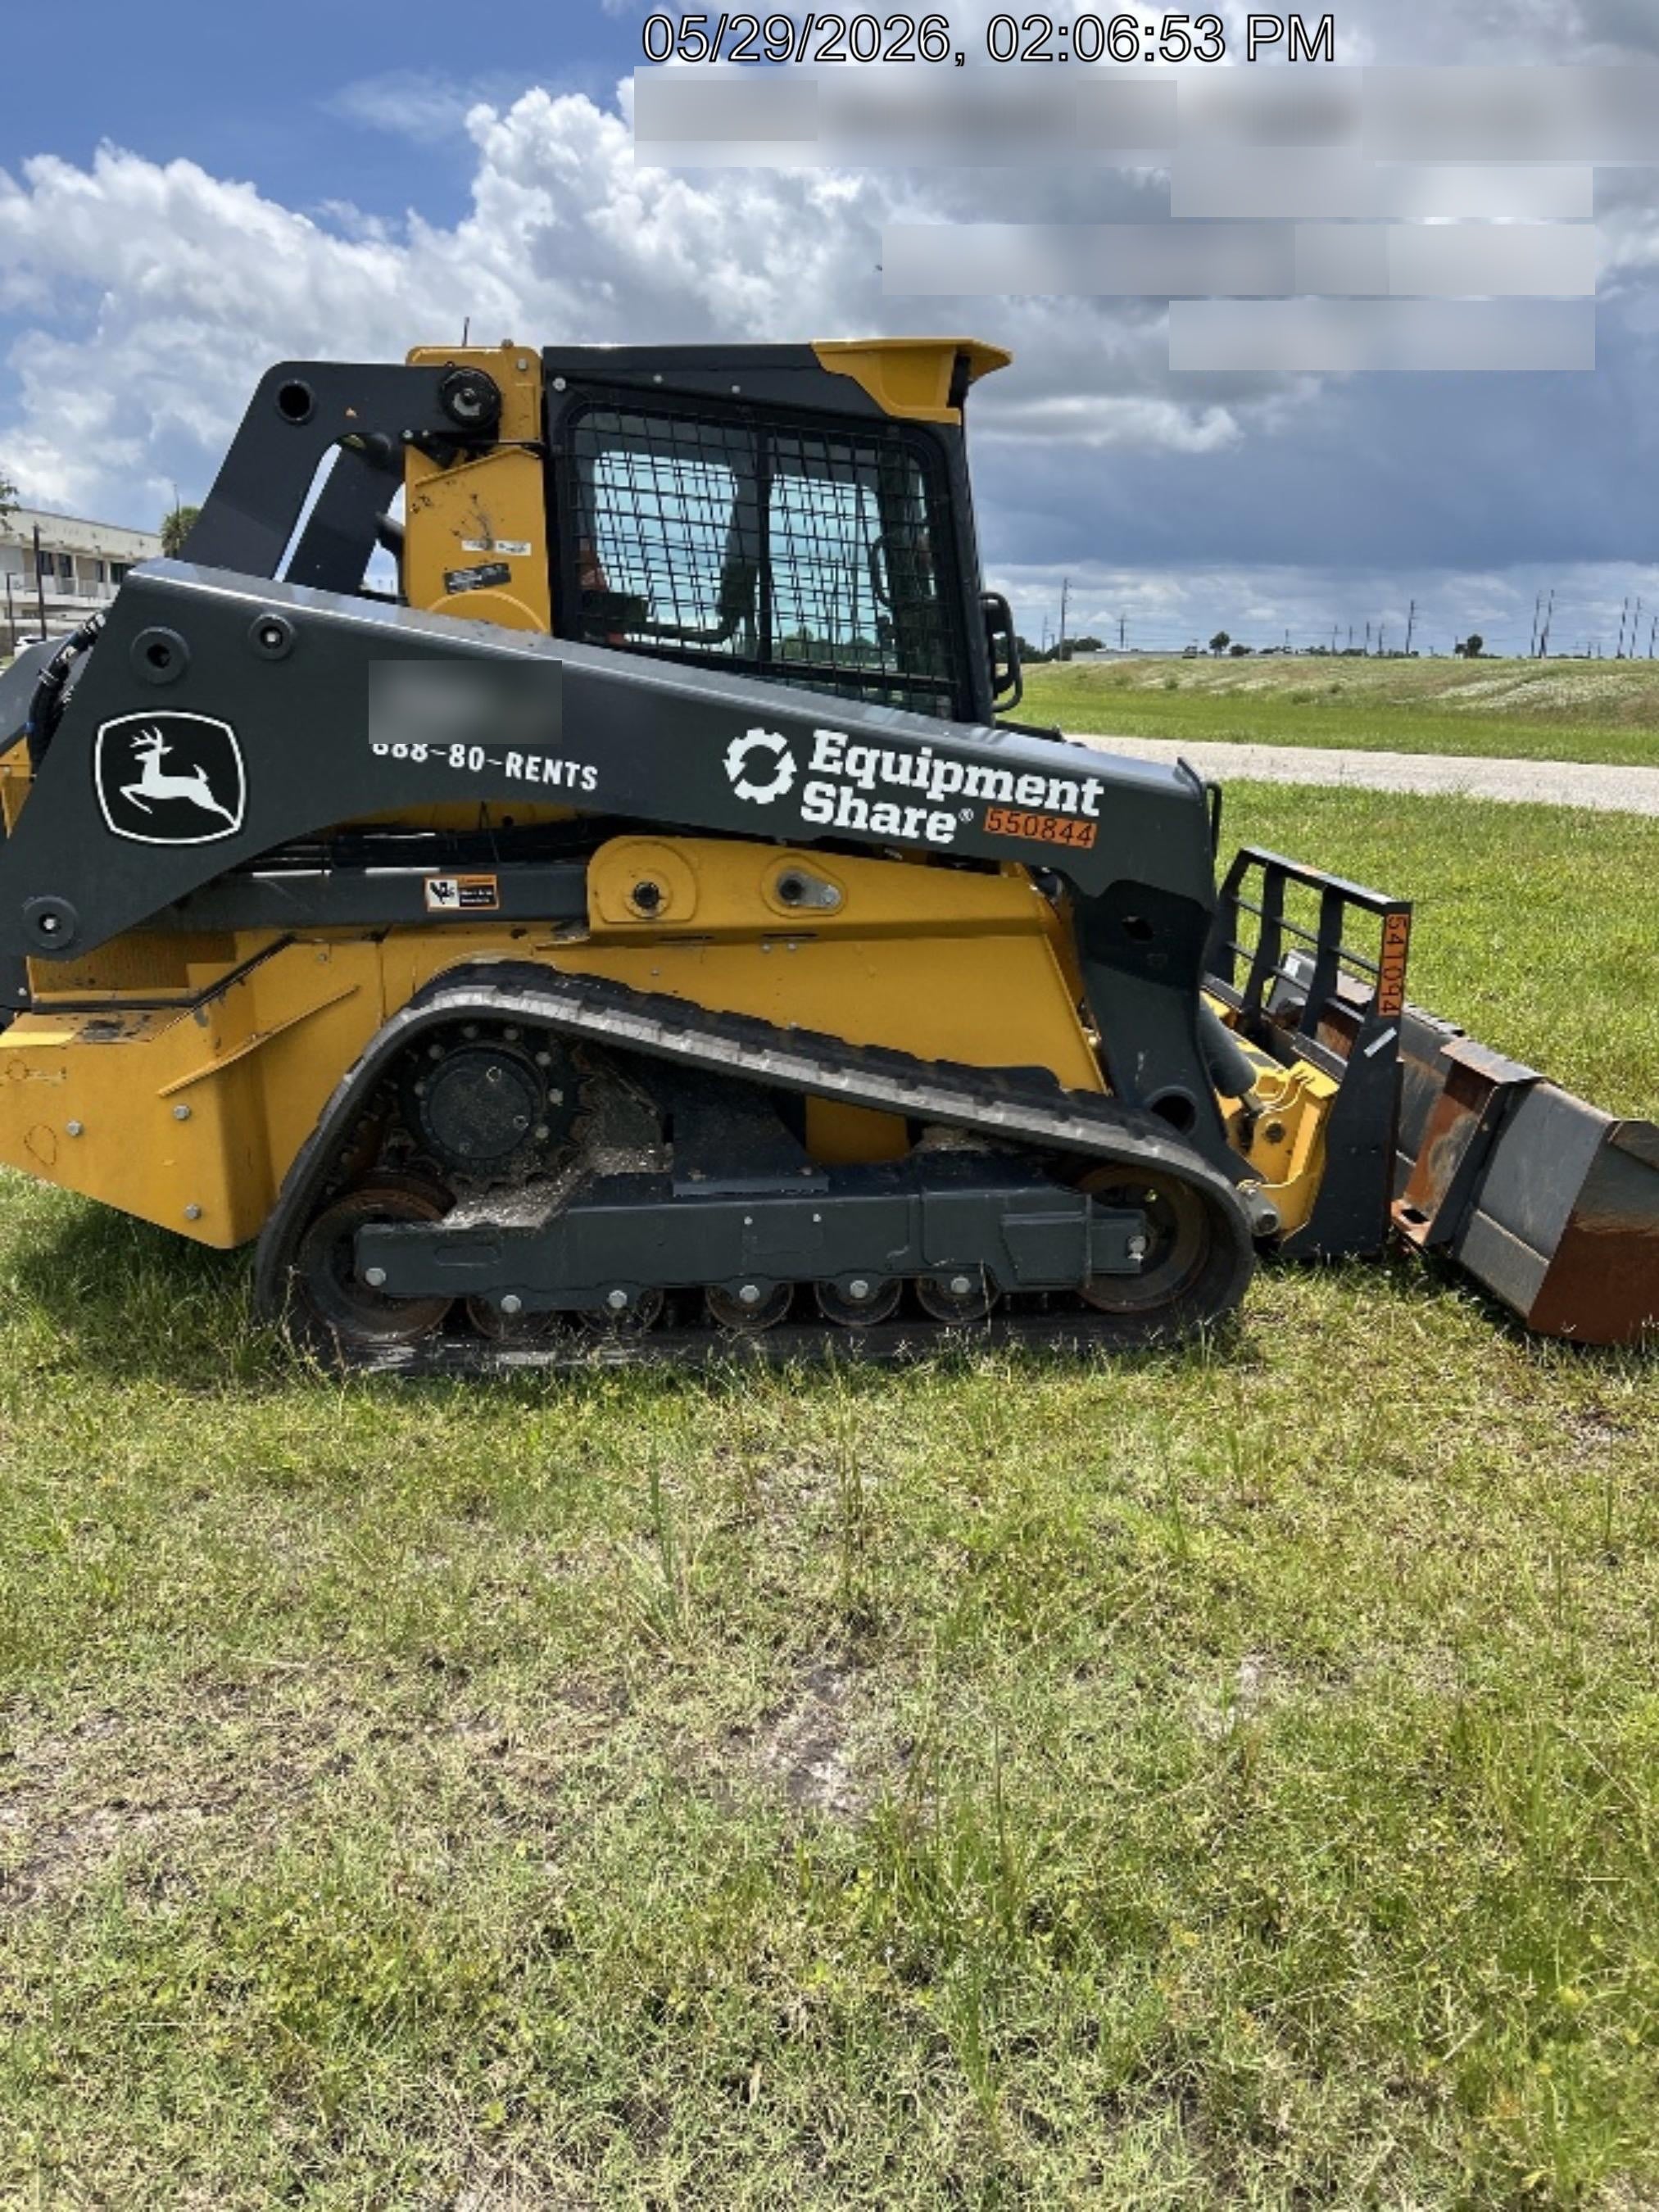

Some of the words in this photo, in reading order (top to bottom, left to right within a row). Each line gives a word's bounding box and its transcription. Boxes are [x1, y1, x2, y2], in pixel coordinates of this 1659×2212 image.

[809, 729, 1104, 816] Equipment
[987, 809, 1092, 846] 550844
[1380, 917, 1407, 1013] 541094
